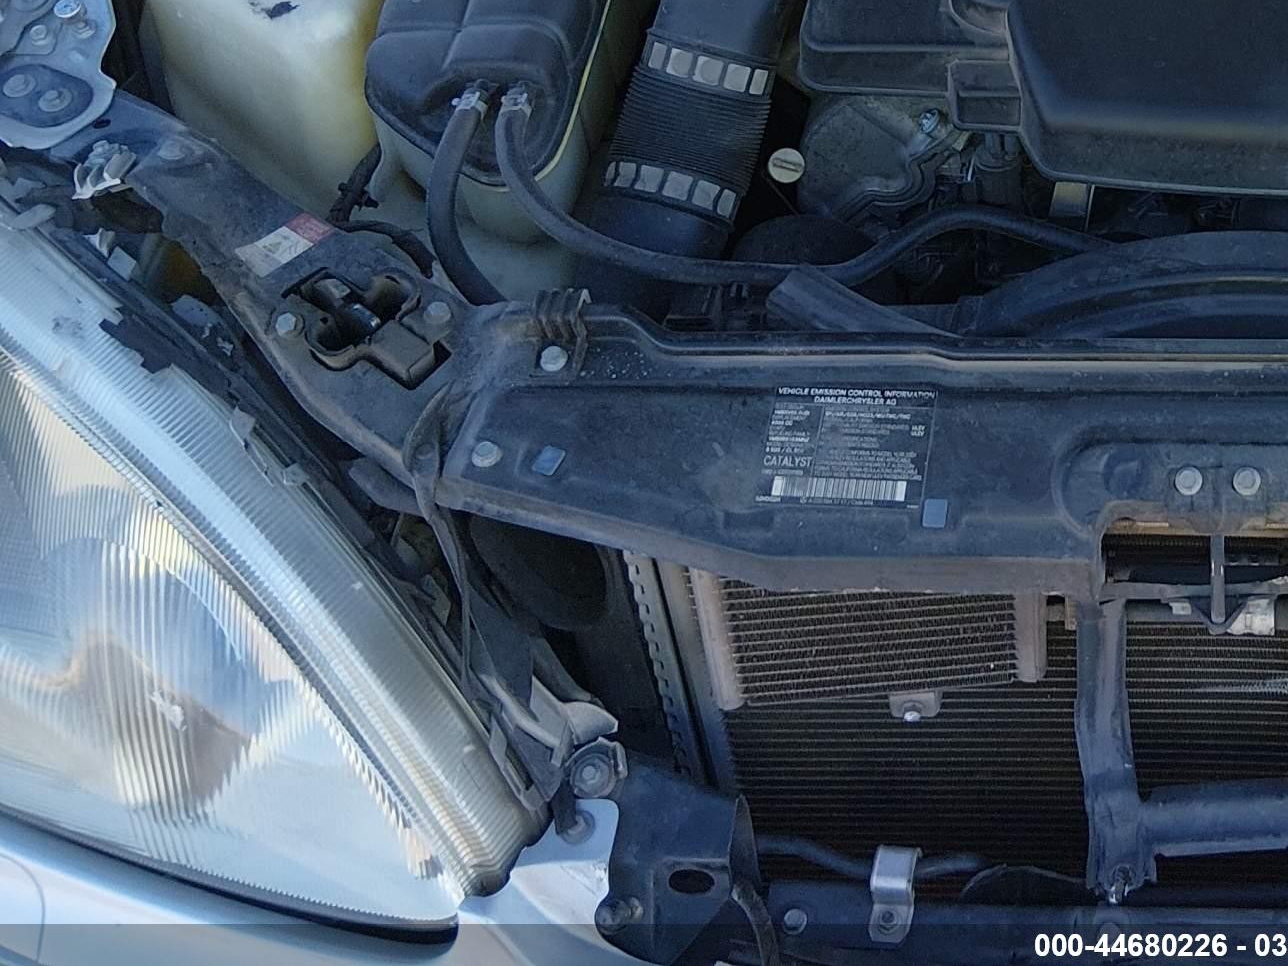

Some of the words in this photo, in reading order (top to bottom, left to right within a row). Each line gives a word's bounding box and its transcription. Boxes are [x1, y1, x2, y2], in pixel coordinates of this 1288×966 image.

[778, 387, 809, 396] VEHICLE
[810, 388, 847, 397] EMISSION
[847, 389, 882, 398] CONTROL
[884, 390, 936, 399] INFORMATION
[813, 396, 884, 405] DAIMLERCHRYSLER
[885, 398, 897, 406] AG
[763, 455, 813, 467] CATALYST
